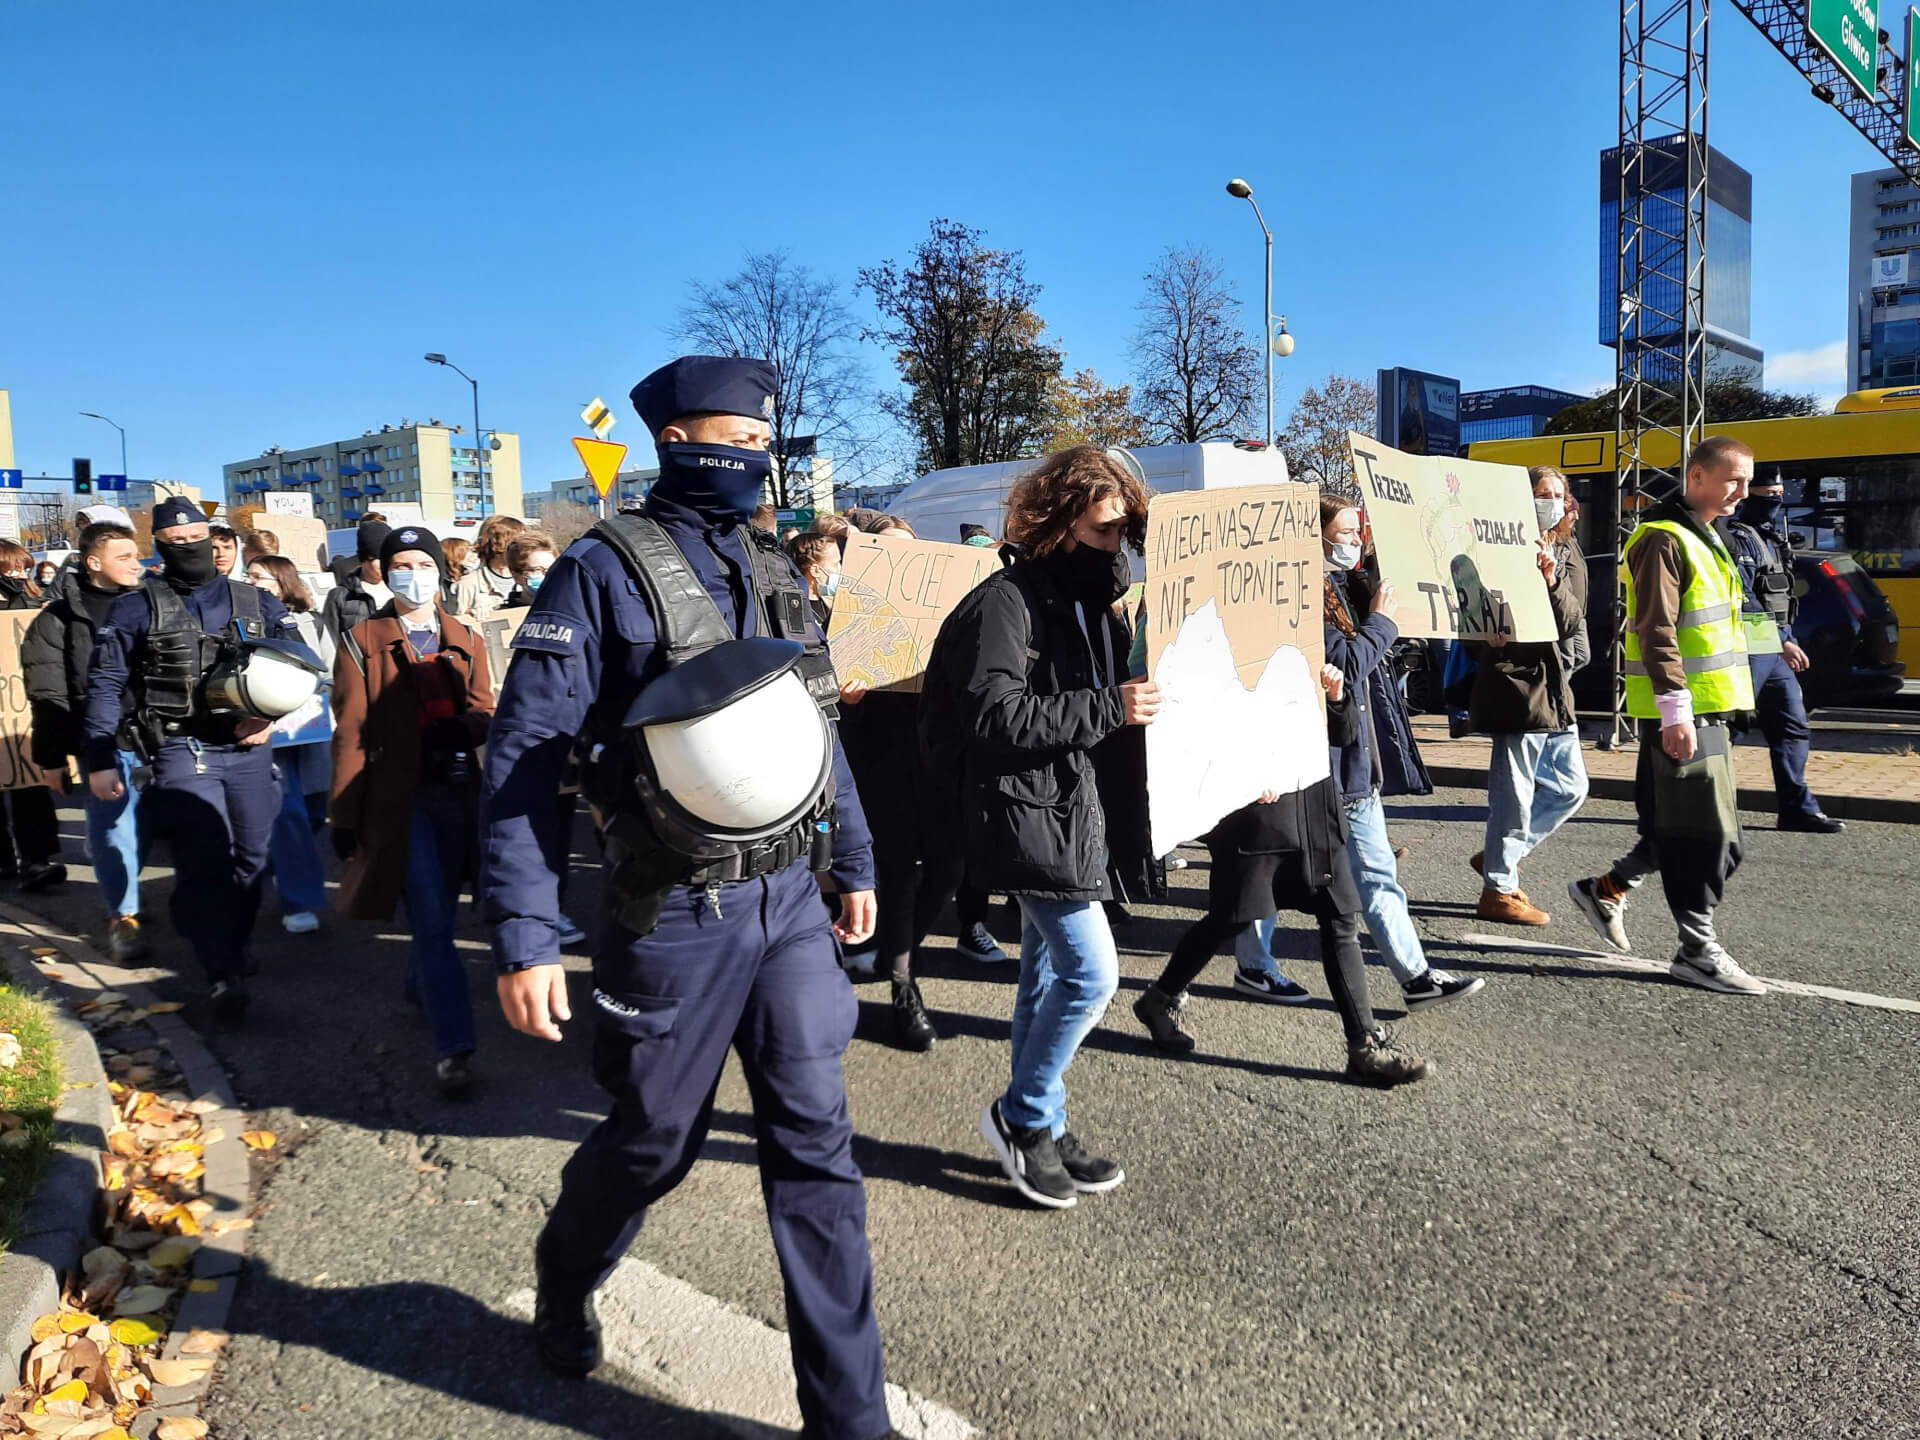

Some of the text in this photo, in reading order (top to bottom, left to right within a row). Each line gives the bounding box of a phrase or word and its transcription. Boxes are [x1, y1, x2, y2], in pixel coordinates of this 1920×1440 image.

[1841, 14, 1870, 71] Gliwice
[700, 457, 746, 471] POLICJA
[1156, 499, 1319, 572] NIECH NASZ ZAPAŁ
[1217, 555, 1311, 629] TOPNIEJE
[1417, 582, 1511, 636] TERAZ
[519, 622, 573, 644] POLICJA
